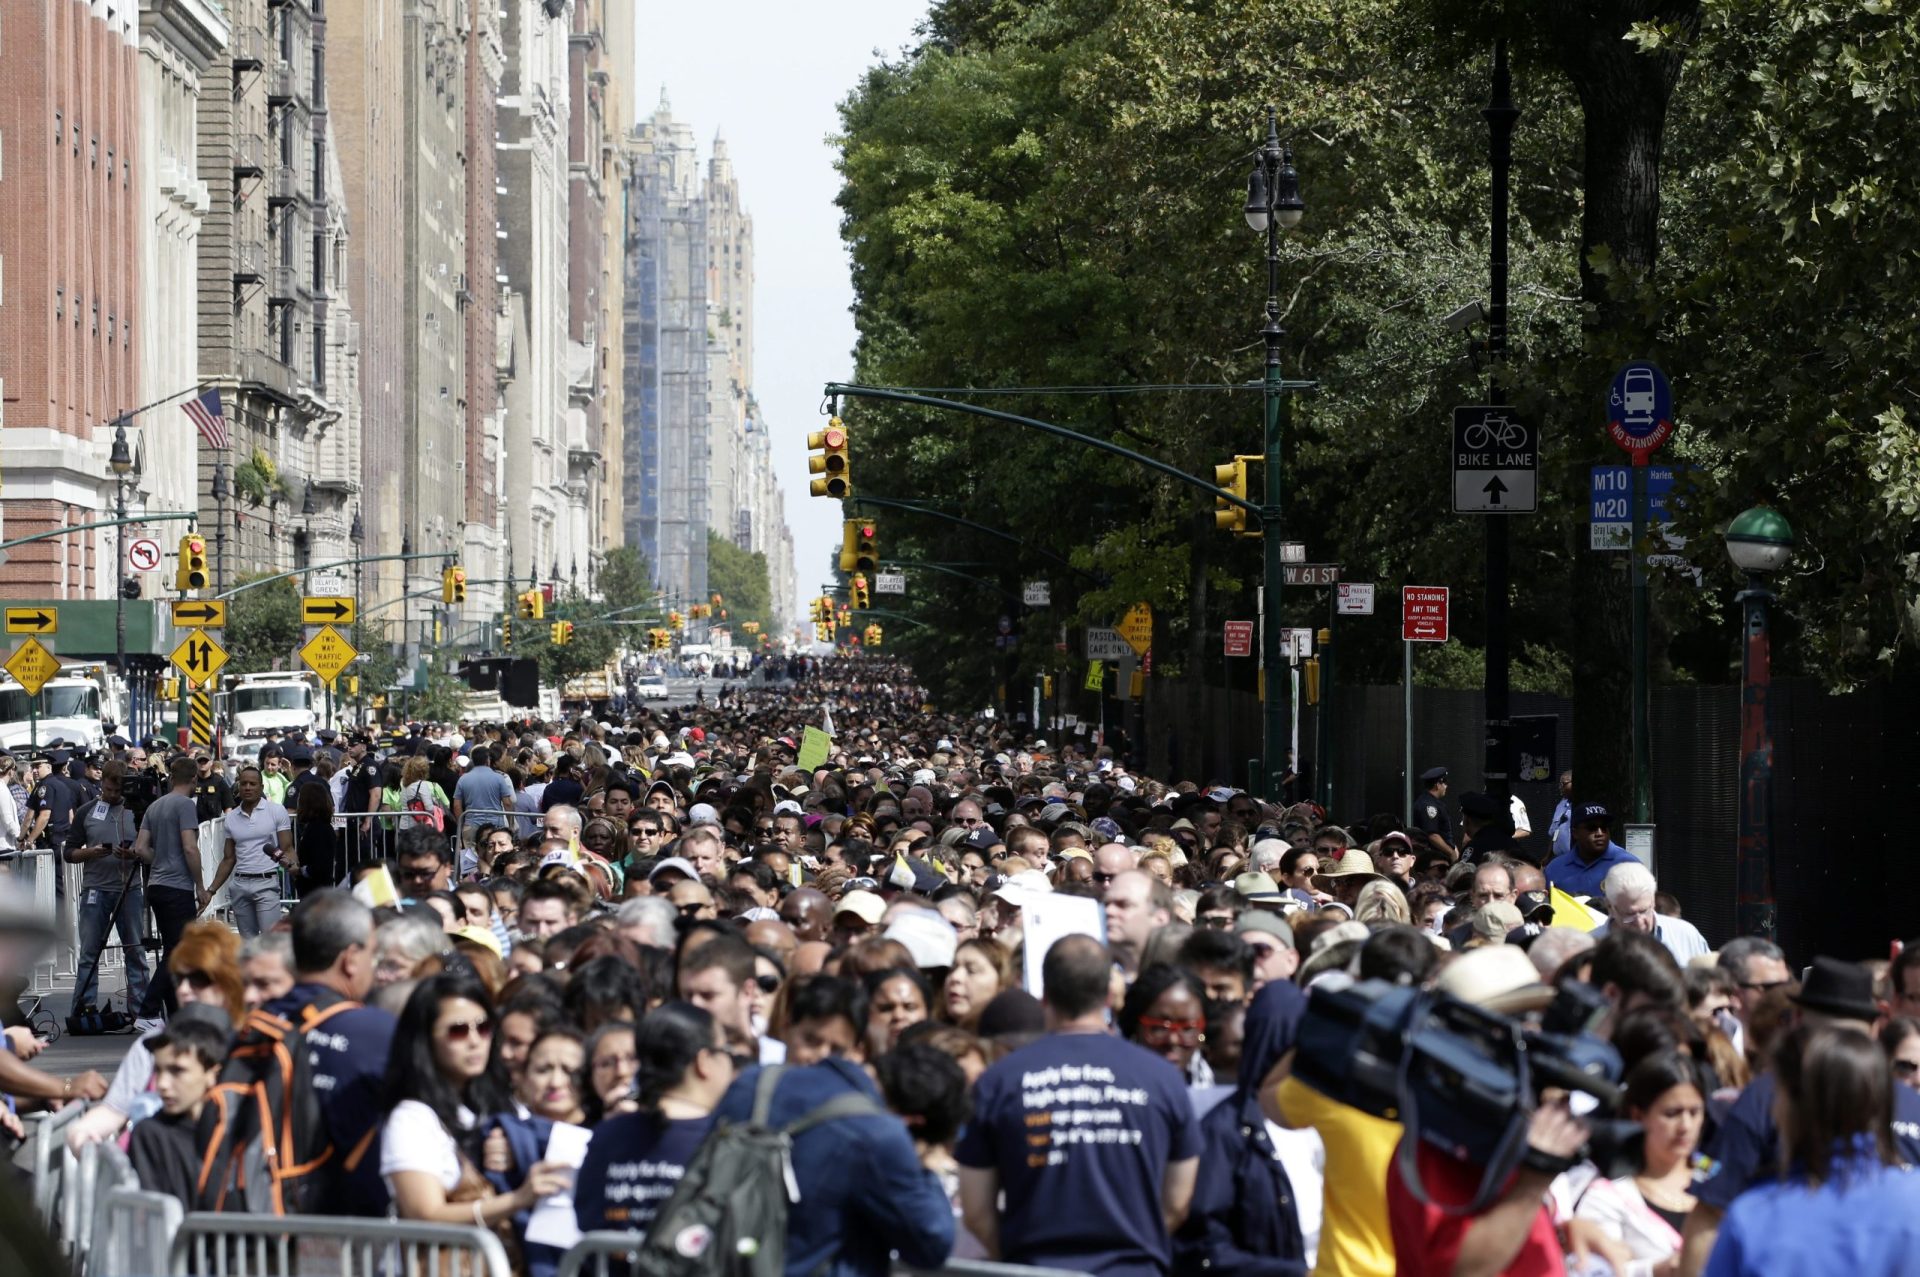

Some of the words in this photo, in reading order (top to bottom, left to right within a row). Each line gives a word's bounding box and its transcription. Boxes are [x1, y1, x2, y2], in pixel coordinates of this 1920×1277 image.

[1611, 424, 1625, 441] NO
[1624, 424, 1666, 449] STANDING
[1458, 453, 1490, 466] BIKE
[1496, 453, 1532, 466] LANE
[1594, 470, 1627, 491] M10
[1594, 498, 1627, 518] M20
[1286, 567, 1297, 582] W
[1302, 567, 1316, 583] 61
[1321, 567, 1339, 583] ST
[316, 586, 339, 594] GREEN
[1339, 585, 1350, 597] NO
[1351, 587, 1372, 595] PARKING
[1407, 593, 1415, 601] NO
[1417, 593, 1445, 601] STANDING
[1412, 605, 1424, 613] ANY
[1426, 605, 1440, 613] TIME
[321, 635, 336, 643] TWO
[321, 644, 335, 652] WAY
[1089, 644, 1108, 655] CARS
[1112, 644, 1131, 655] ONLY
[25, 656, 38, 664] WAY
[315, 653, 342, 661] TRAFFIC
[20, 665, 45, 673] TRAFFIC
[317, 662, 339, 670] AHEAD
[22, 674, 44, 682] AHEAD
[1022, 1066, 1060, 1089] Apply
[1061, 1063, 1082, 1081] for
